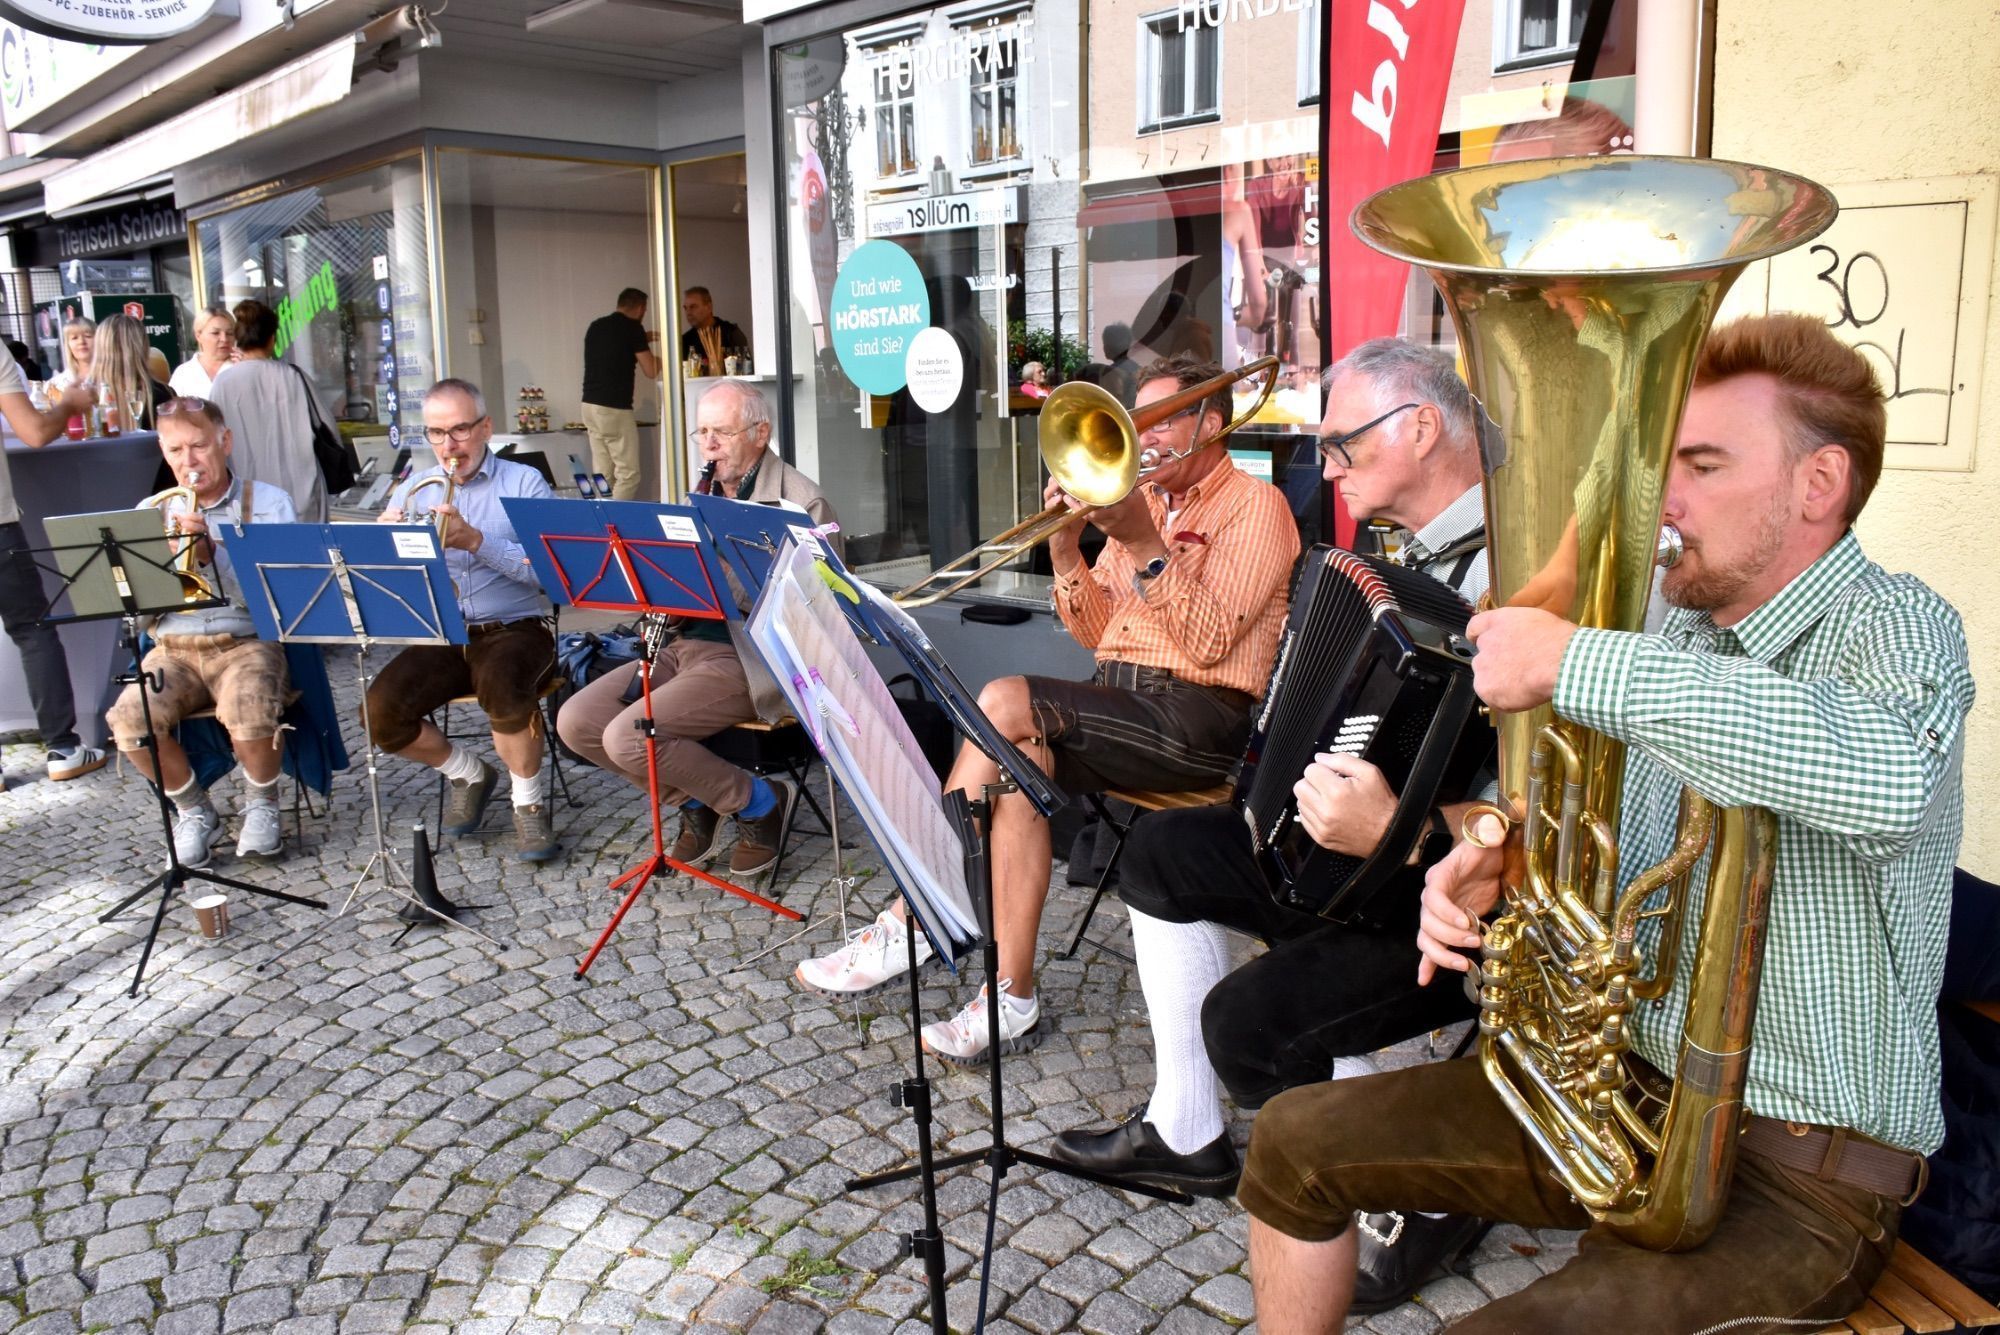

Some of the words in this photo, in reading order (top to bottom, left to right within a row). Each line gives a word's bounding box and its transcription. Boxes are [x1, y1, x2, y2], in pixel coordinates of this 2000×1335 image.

[82, 4, 136, 20] ZUBEHÖR
[145, 4, 188, 20] SERVICE
[878, 16, 1036, 96] HÖRGERÄTE
[57, 215, 119, 256] Tierisch
[120, 203, 177, 245] Schön
[850, 277, 876, 297] Und
[878, 275, 902, 294] wie
[1810, 244, 1889, 329] 30
[835, 303, 922, 330] HÖRSTARK
[854, 337, 879, 356] sind
[881, 336, 904, 354] Sie?
